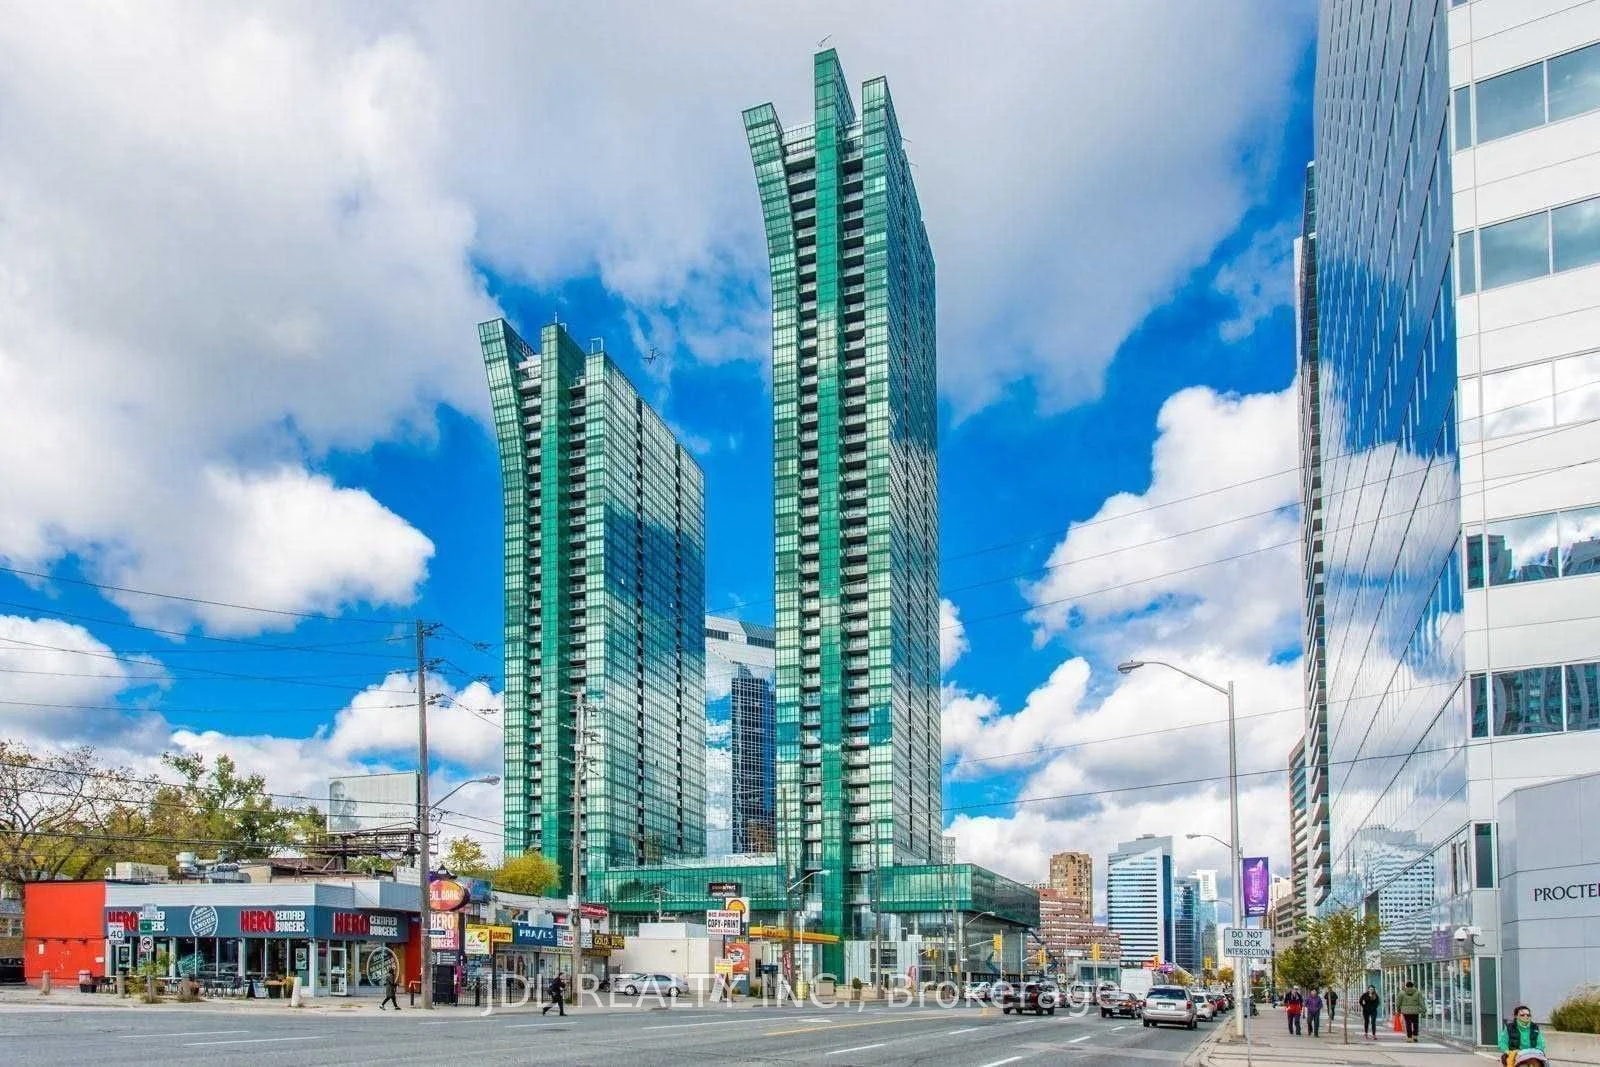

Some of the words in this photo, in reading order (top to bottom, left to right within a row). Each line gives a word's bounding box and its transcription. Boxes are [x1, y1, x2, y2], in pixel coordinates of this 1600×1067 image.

[1534, 883, 1600, 902] PROCTE
[241, 910, 275, 933] HERO
[275, 910, 306, 921] CERTIFIED
[275, 921, 307, 932] BURGERS
[333, 912, 369, 936] HERO
[369, 915, 398, 926] CERTIFIED
[431, 913, 453, 929] HERO
[110, 930, 123, 939] 40
[369, 925, 398, 937] BURGERS
[1247, 931, 1263, 939] NOT
[1225, 948, 1270, 956] INTERSECTION
